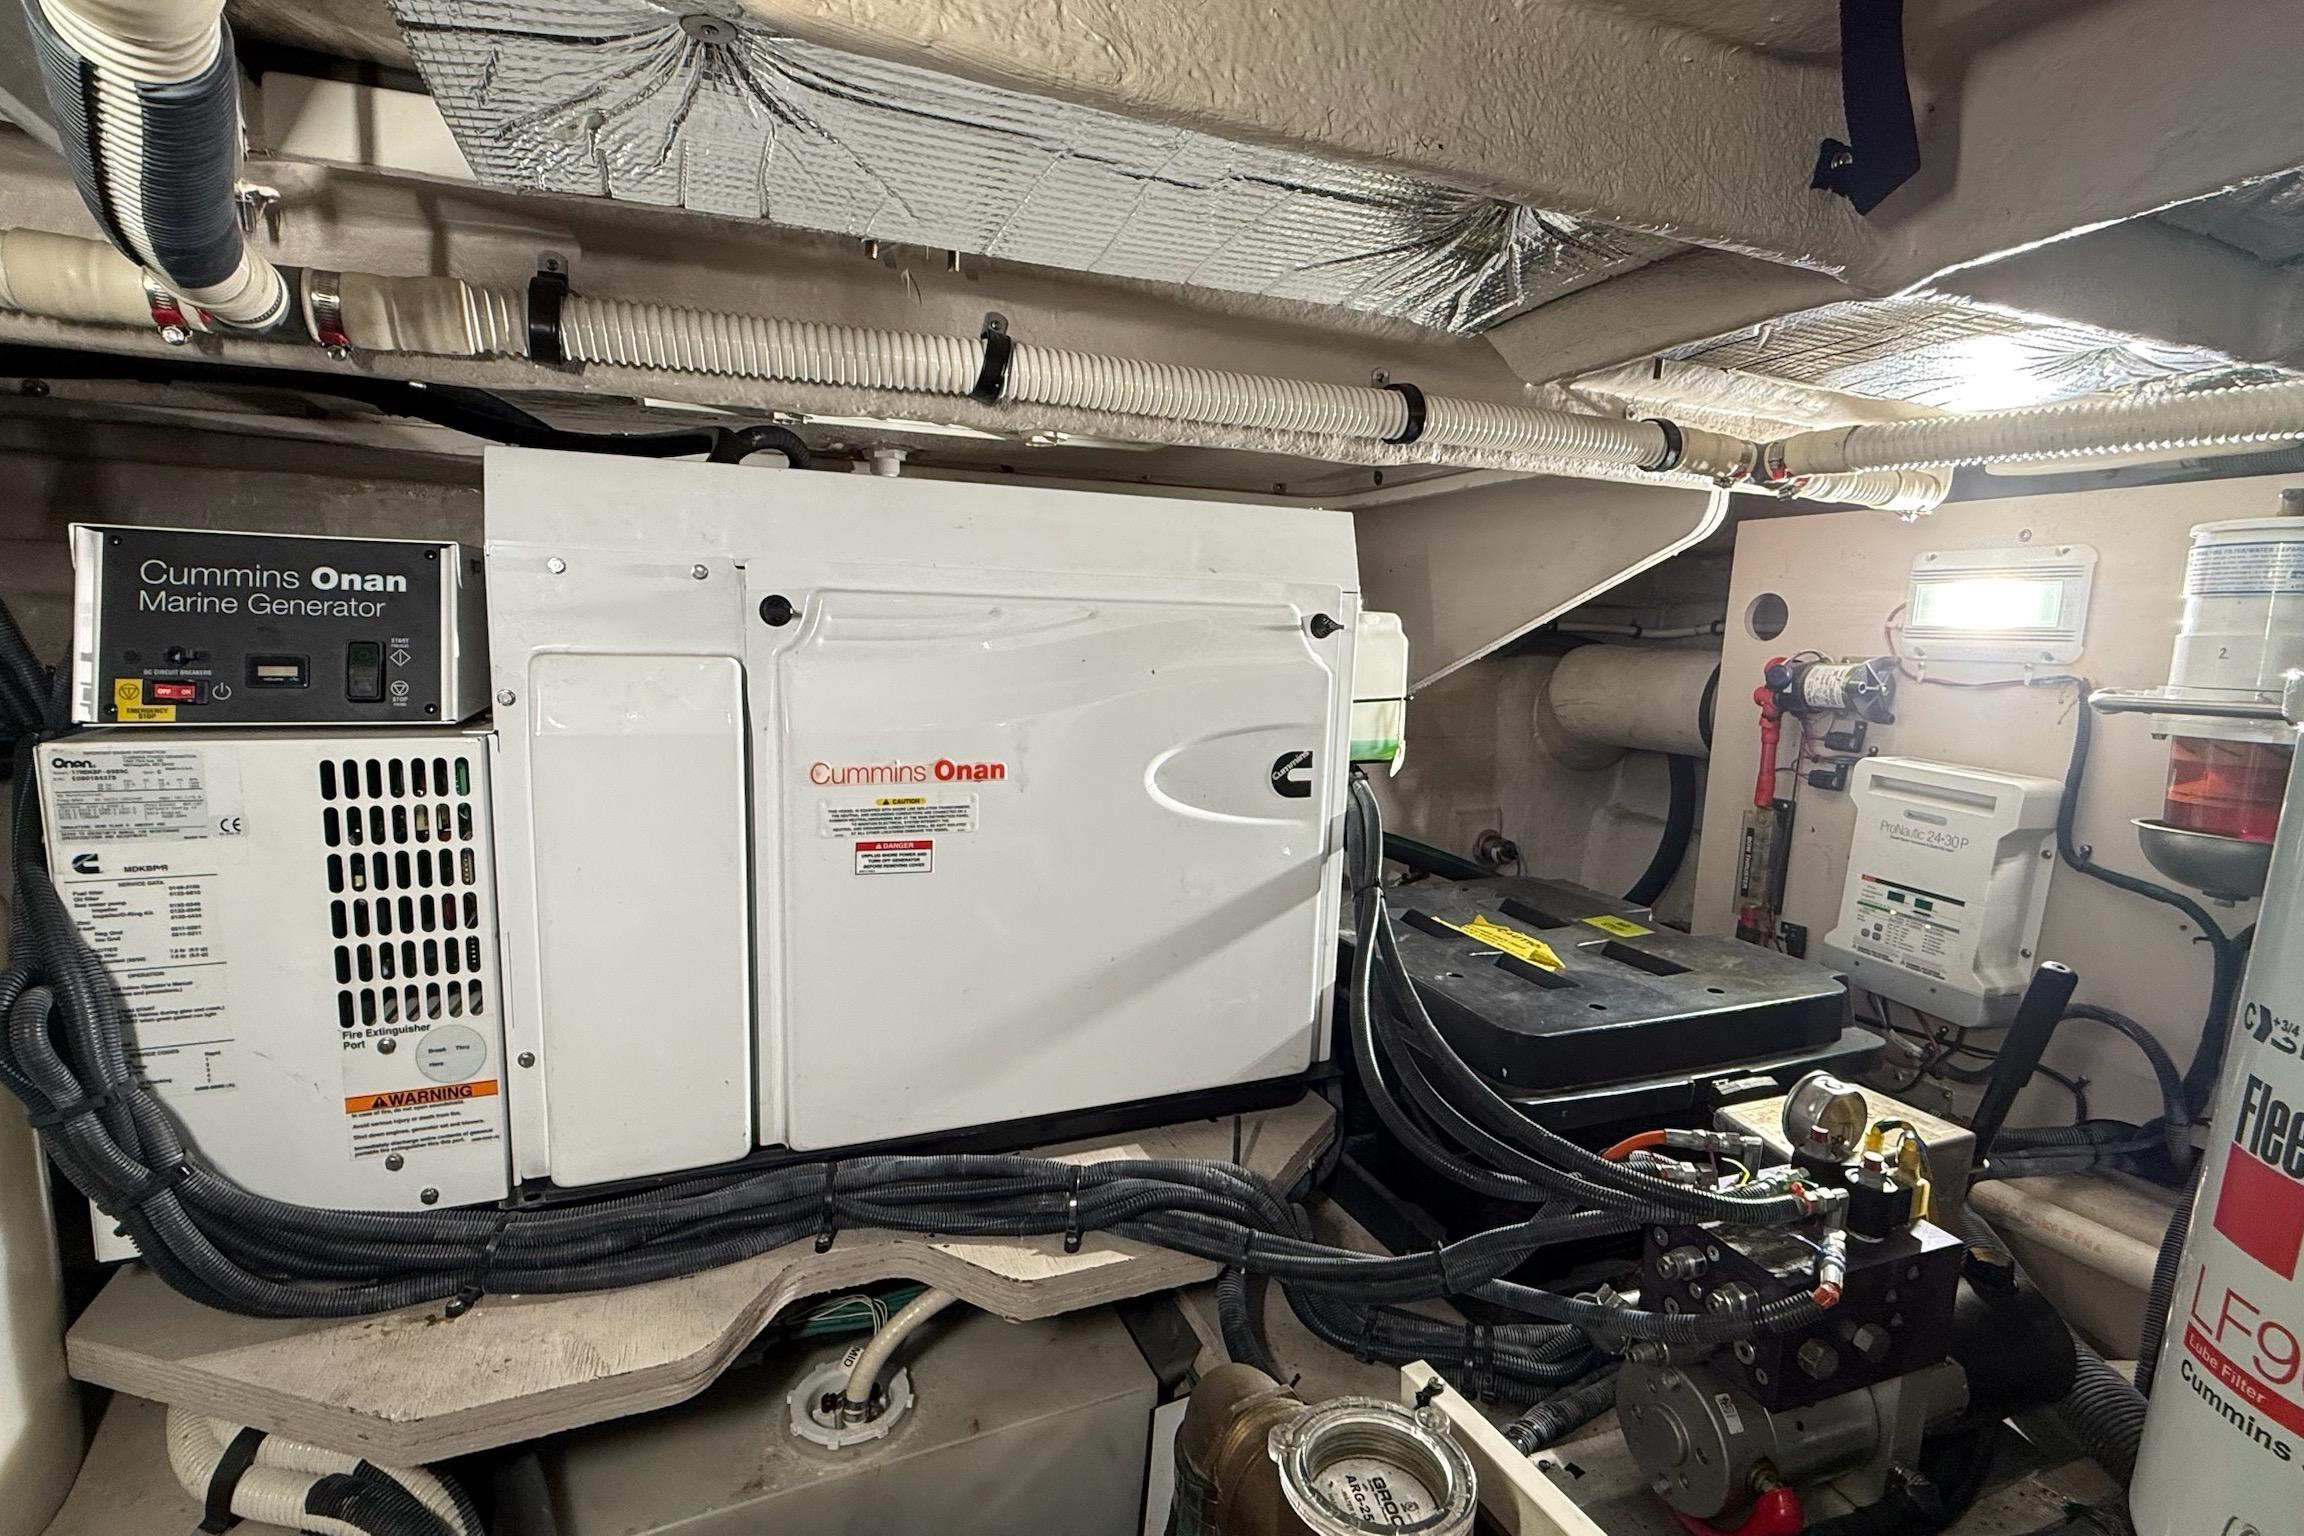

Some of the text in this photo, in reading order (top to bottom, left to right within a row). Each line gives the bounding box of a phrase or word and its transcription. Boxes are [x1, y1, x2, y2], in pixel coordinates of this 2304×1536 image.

[140, 559, 407, 592] Cummins Onan
[139, 590, 386, 618] Marine Generator
[2218, 648, 2228, 660] 2
[157, 687, 192, 696] OFF ON
[52, 758, 92, 768] Onan
[810, 759, 1005, 785] Cummins Onan
[1272, 751, 1310, 780] Cummins
[1880, 820, 1925, 840] ProNautic
[342, 1023, 431, 1040] Fire Extinguisher
[343, 1040, 366, 1050] Port
[388, 1085, 472, 1108] WARNING
[2190, 1264, 2304, 1386] LF9
[844, 1346, 861, 1367] MID
[2189, 1334, 2266, 1405] Lube Filter
[2180, 1358, 2291, 1462] Cummins
[1345, 1475, 1375, 1522] ARG-25
